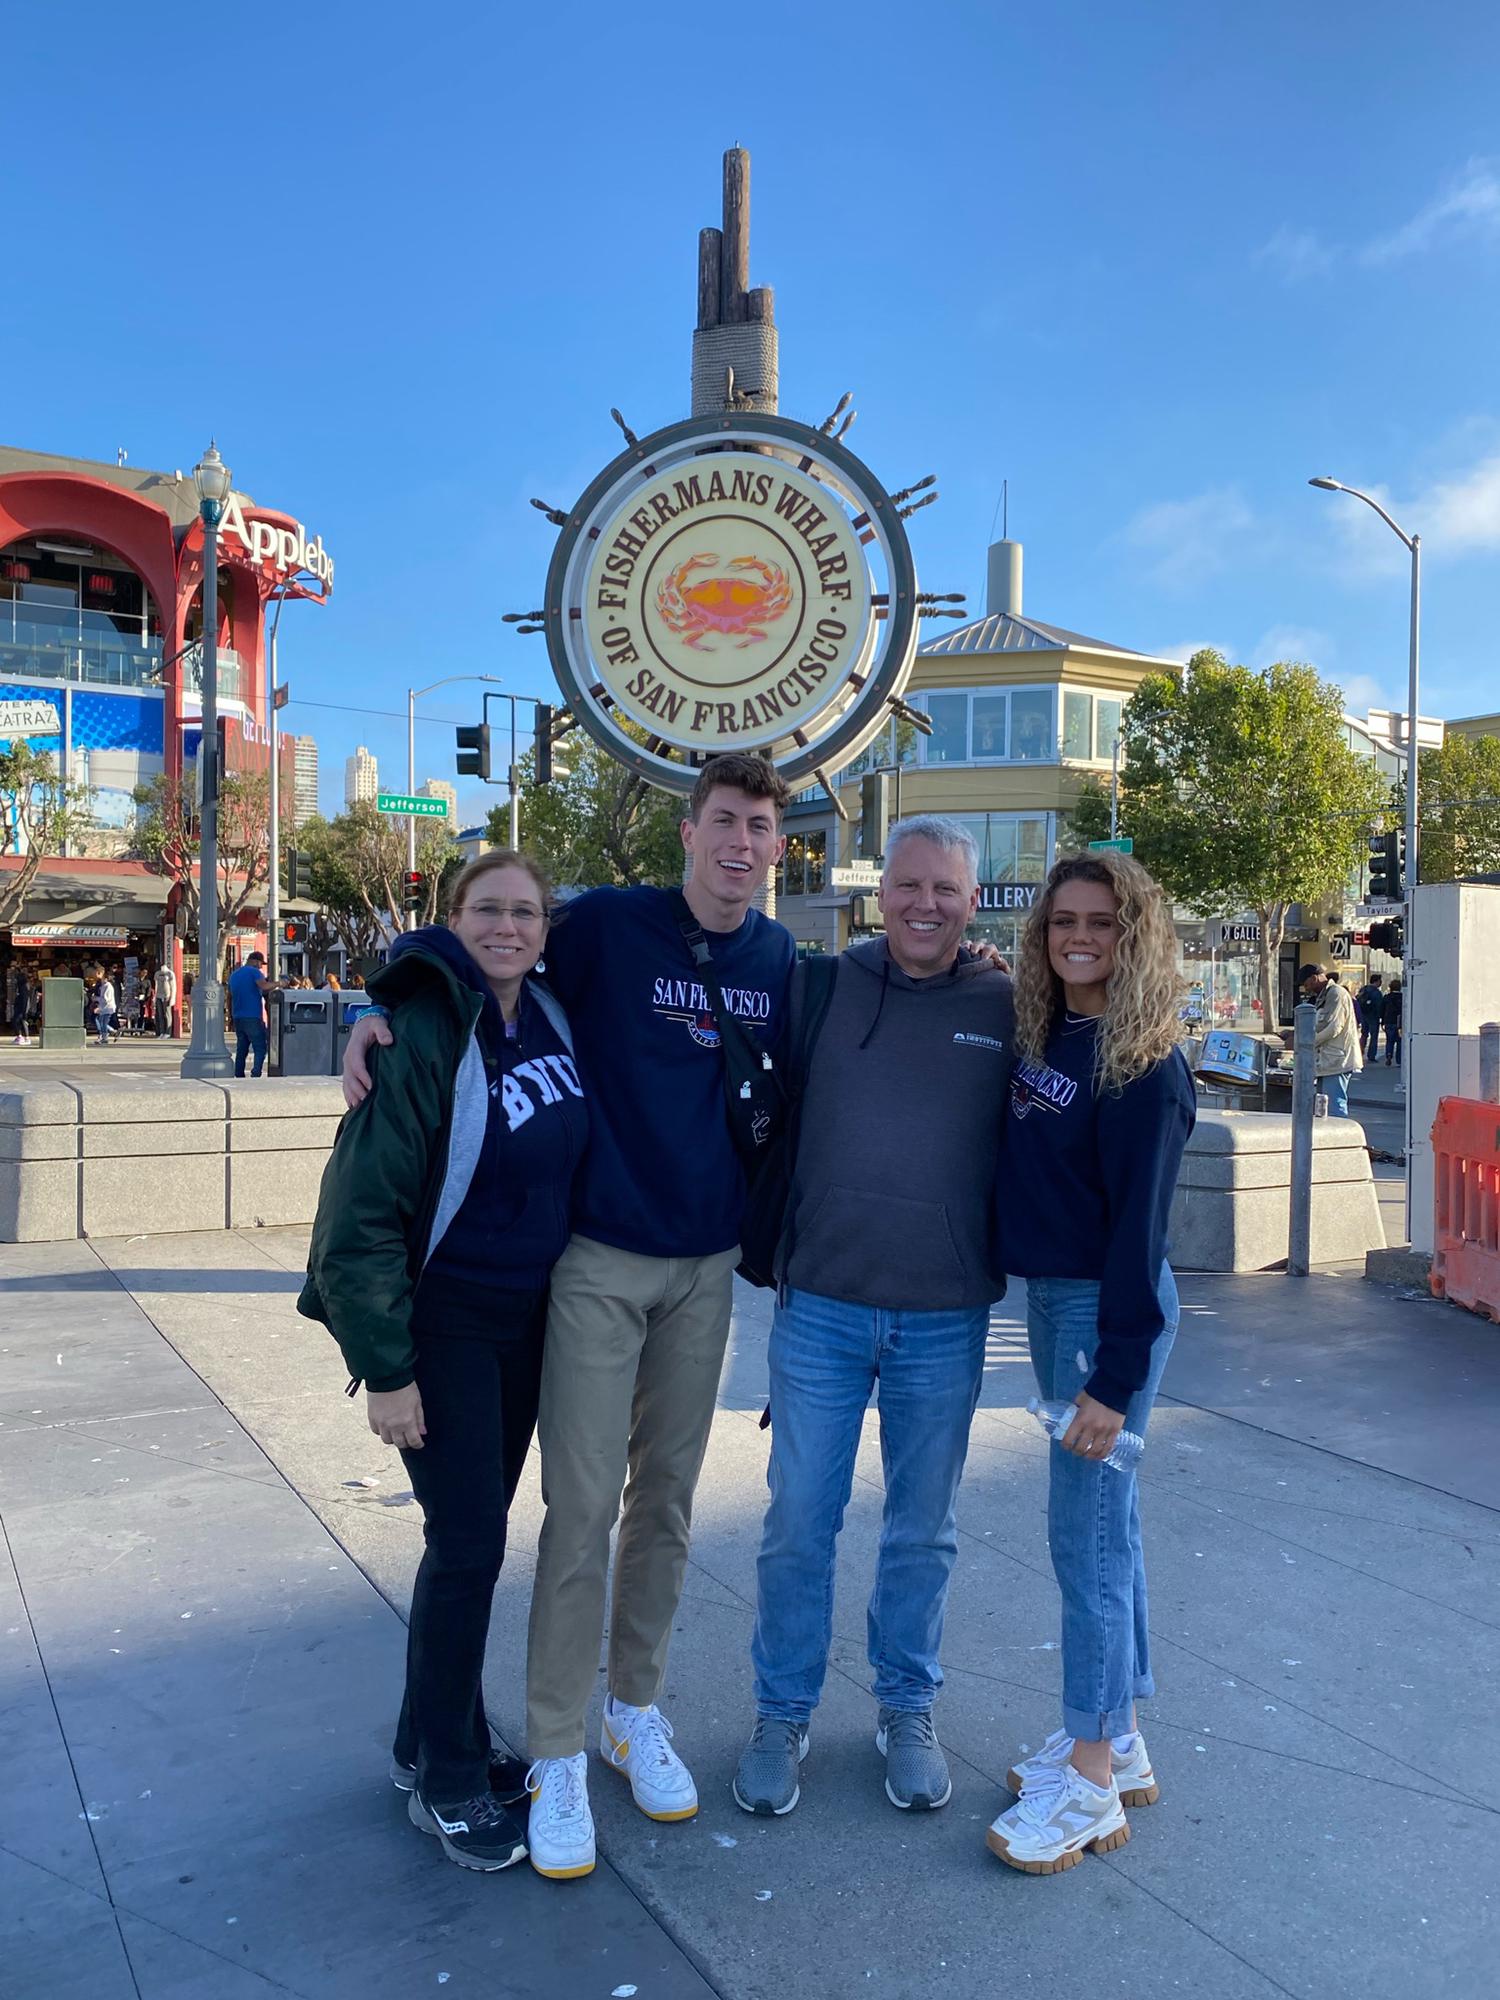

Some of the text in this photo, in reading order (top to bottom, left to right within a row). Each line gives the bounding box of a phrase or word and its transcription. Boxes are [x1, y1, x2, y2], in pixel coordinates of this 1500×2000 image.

[597, 470, 852, 610] FISHERMANS WHARF
[601, 618, 847, 734] OF SAN FRANCISCO
[381, 798, 444, 814] Jefferson
[838, 872, 880, 883] Jefferso
[977, 887, 1036, 908] LLERY
[1366, 906, 1393, 916] Taylor
[19, 926, 120, 937] WHARF CENTRAL
[1233, 926, 1261, 941] GALLE
[652, 977, 770, 1018] SAN FRNCISCO
[688, 1020, 721, 1047] CALIFO
[489, 1054, 585, 1133] BYU
